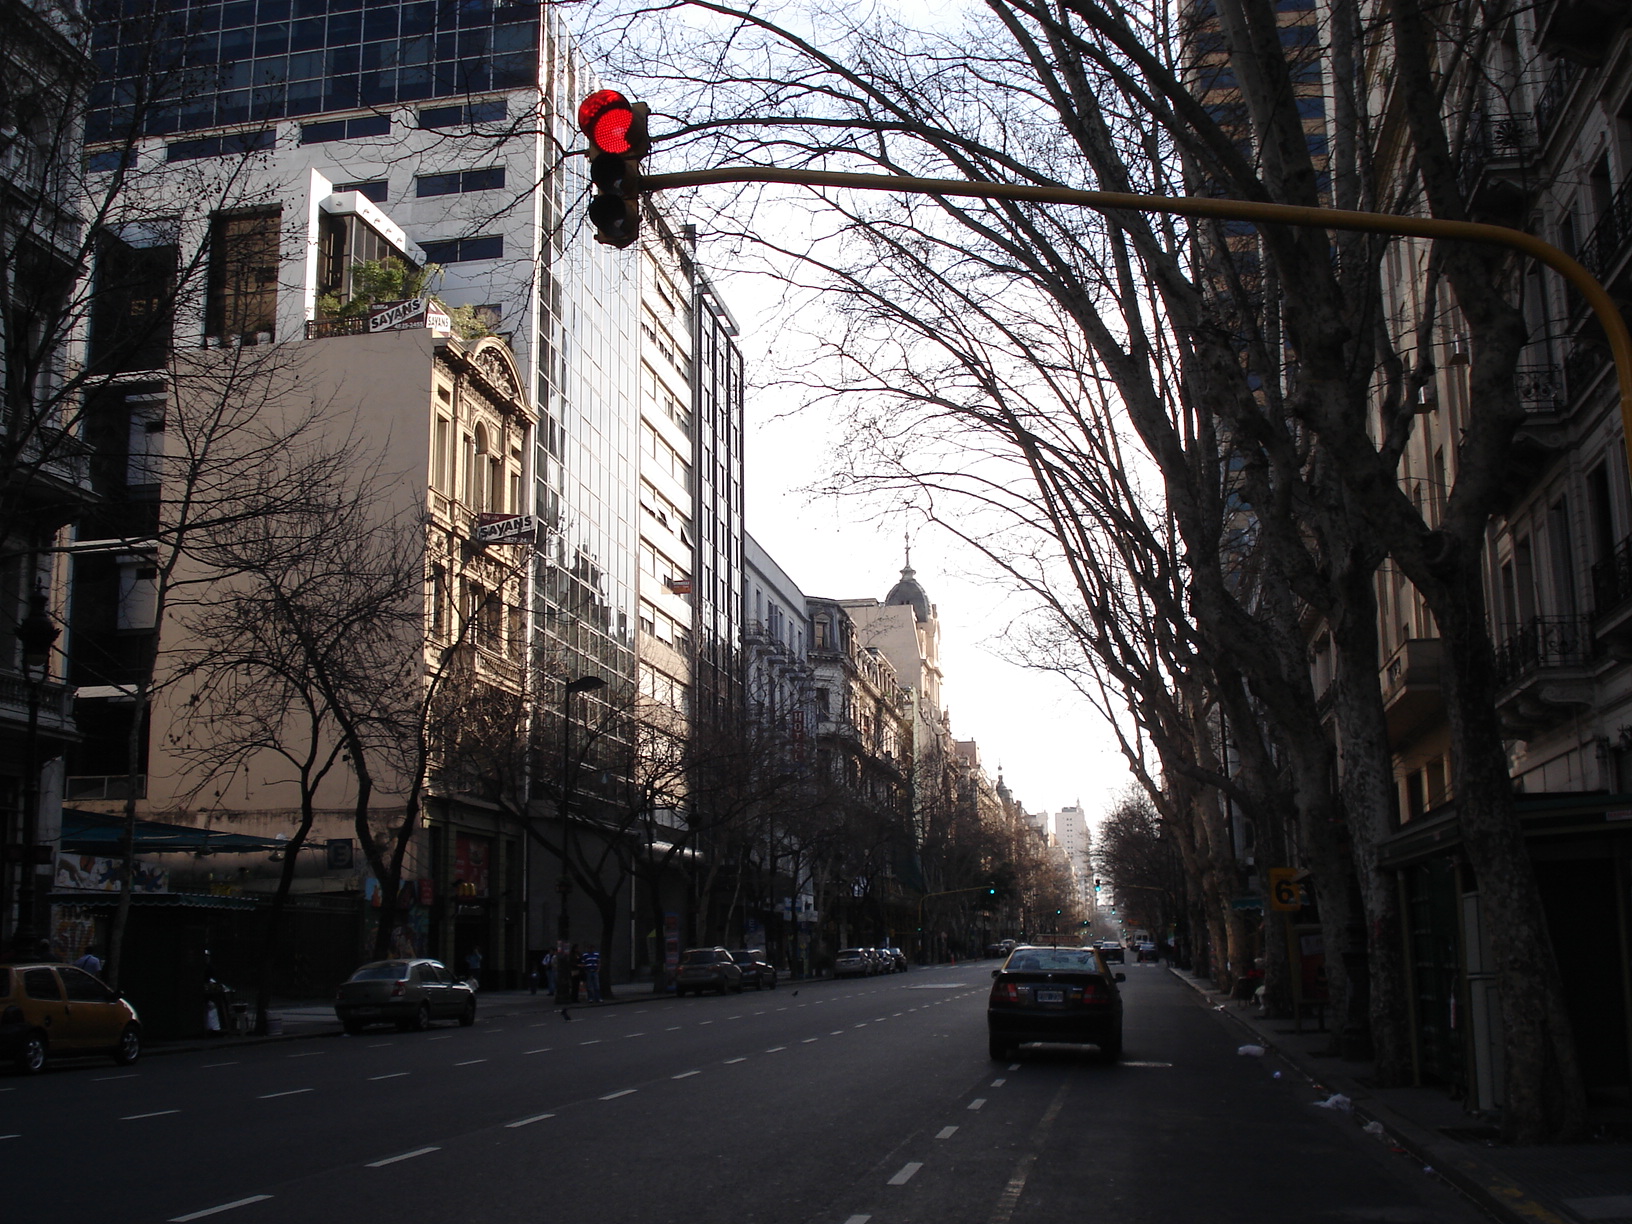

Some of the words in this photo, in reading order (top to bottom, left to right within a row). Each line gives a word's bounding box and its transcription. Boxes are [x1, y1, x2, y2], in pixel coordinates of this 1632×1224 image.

[371, 299, 420, 329] SAYANS
[428, 315, 449, 327] SAYANS
[480, 515, 532, 538] SAYANS
